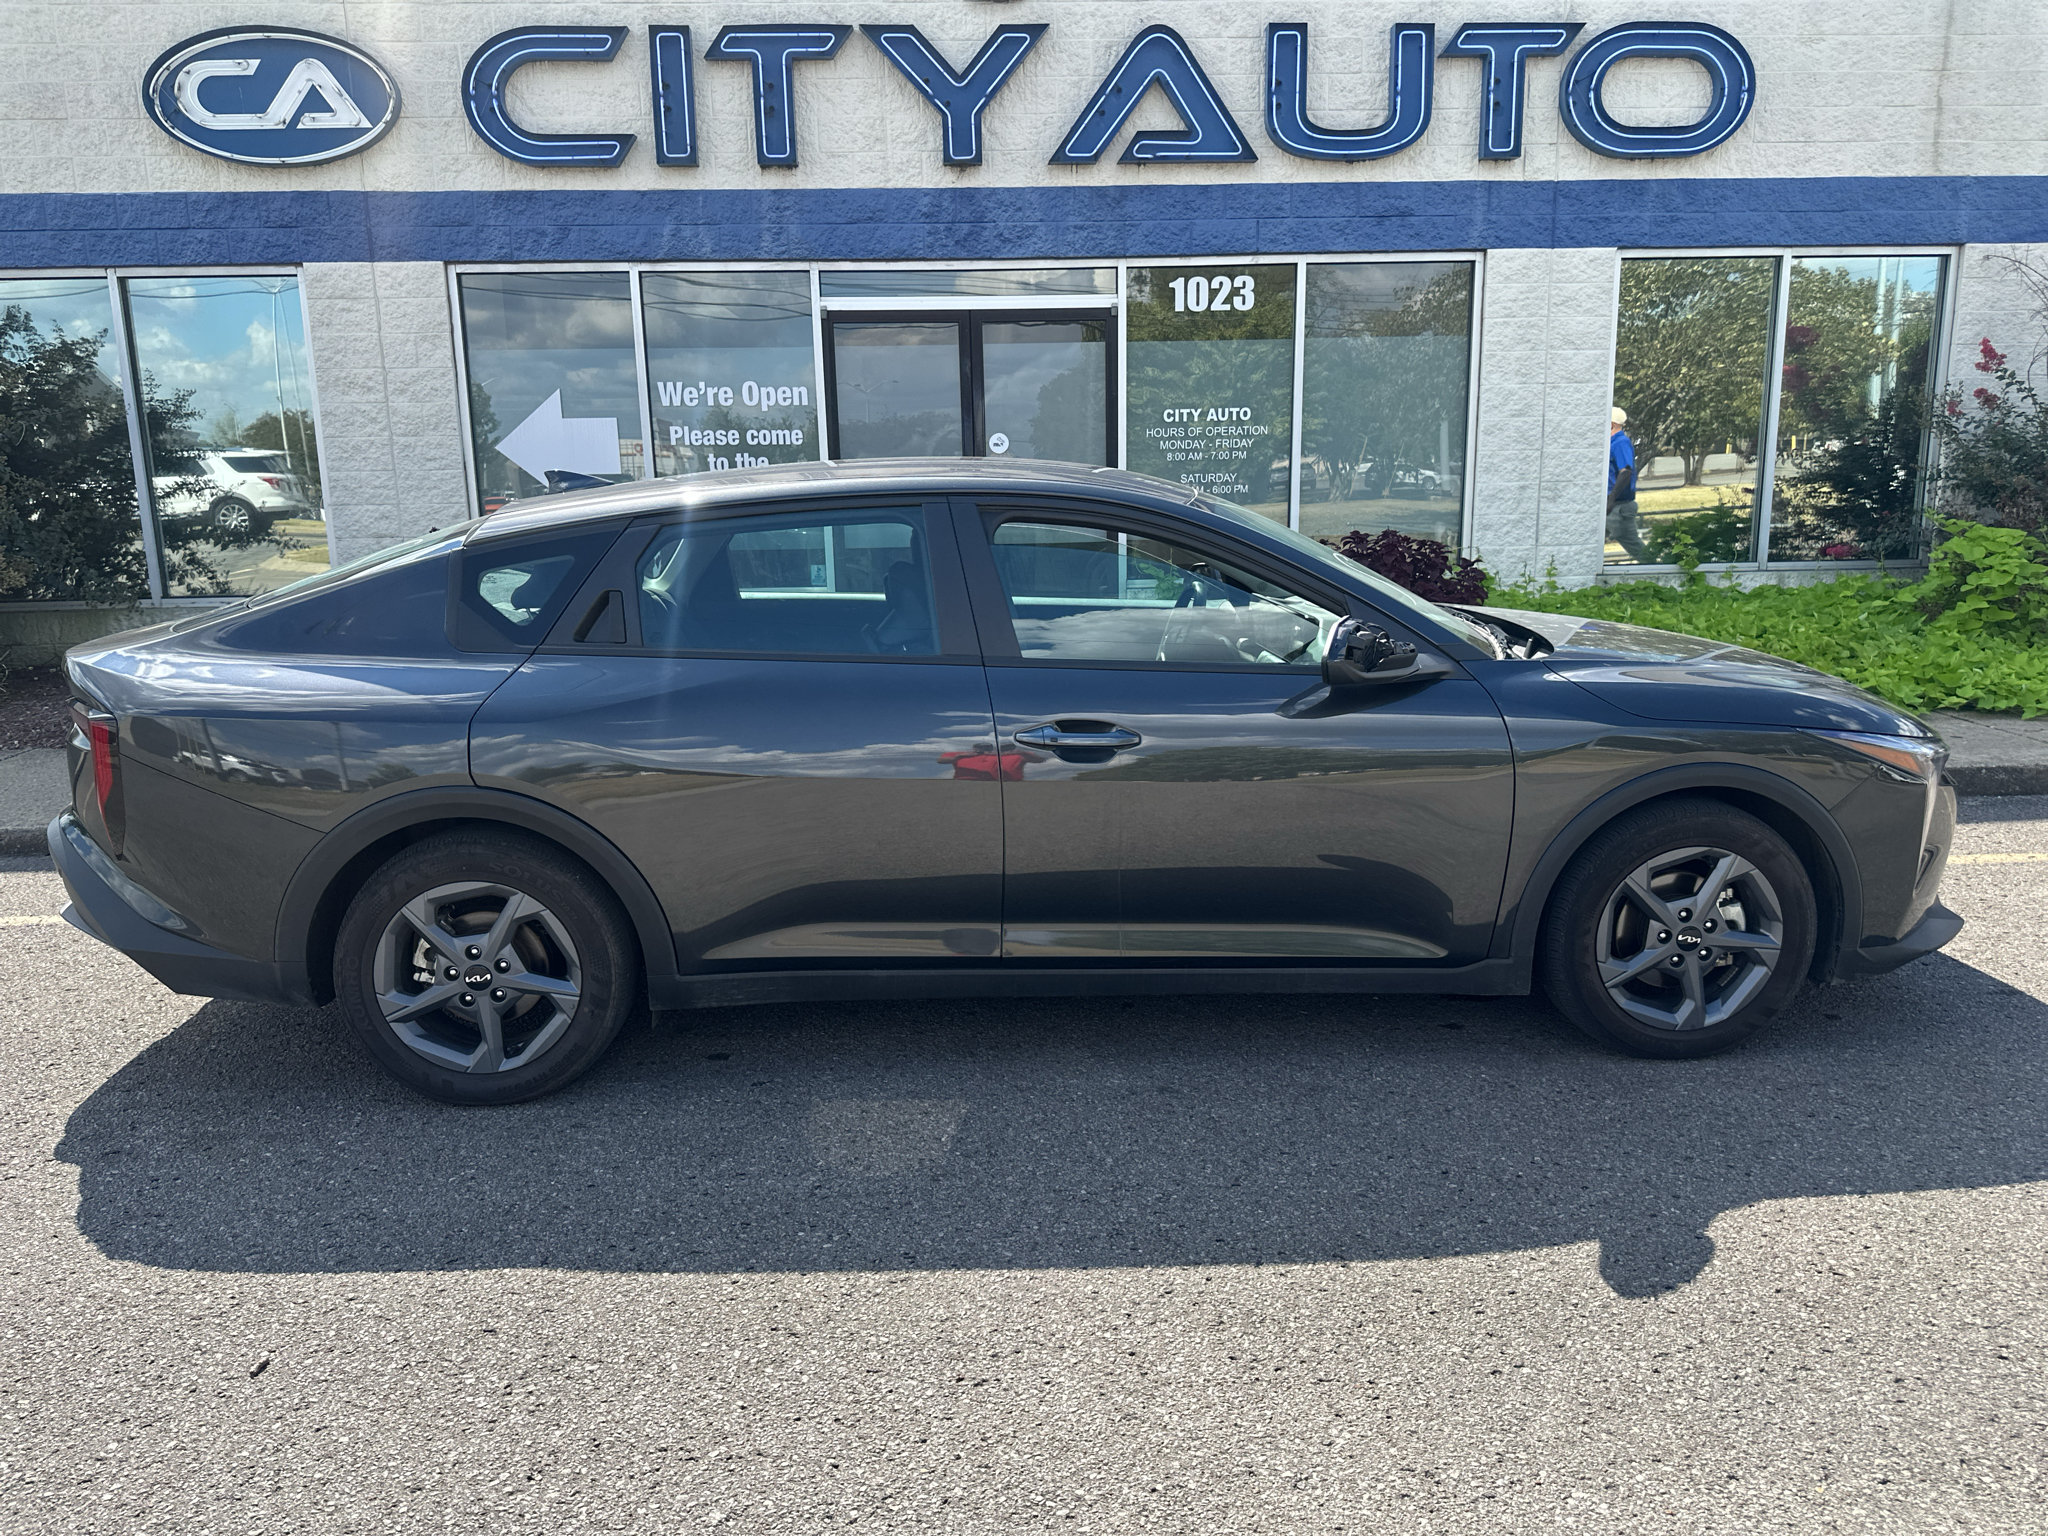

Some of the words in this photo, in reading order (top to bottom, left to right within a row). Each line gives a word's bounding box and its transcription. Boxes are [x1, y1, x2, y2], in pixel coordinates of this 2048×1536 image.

[174, 58, 373, 130] CA
[461, 23, 1049, 168] CITY
[1048, 20, 1757, 166] AUTO
[1168, 275, 1255, 312] 1023
[657, 381, 734, 407] We're
[741, 380, 809, 412] Open
[1163, 408, 1202, 422] CITY
[1206, 407, 1252, 422] AUTO
[669, 425, 740, 446] Please
[746, 428, 804, 446] come
[1146, 427, 1185, 438] HOURS
[1187, 427, 1203, 437] OF
[1205, 425, 1268, 437] OPERATION
[1160, 440, 1206, 450] MONDAY
[1215, 438, 1254, 448] FRIDAY
[707, 453, 730, 472] to
[1166, 452, 1186, 461] 8:00
[1187, 451, 1203, 461] AM
[1211, 451, 1230, 460] 7:00
[1232, 450, 1247, 460] PM
[1180, 473, 1238, 483] SATURDAY
[1212, 485, 1231, 494] 6:00
[1233, 484, 1249, 493] PM
[465, 973, 491, 983] KIA
